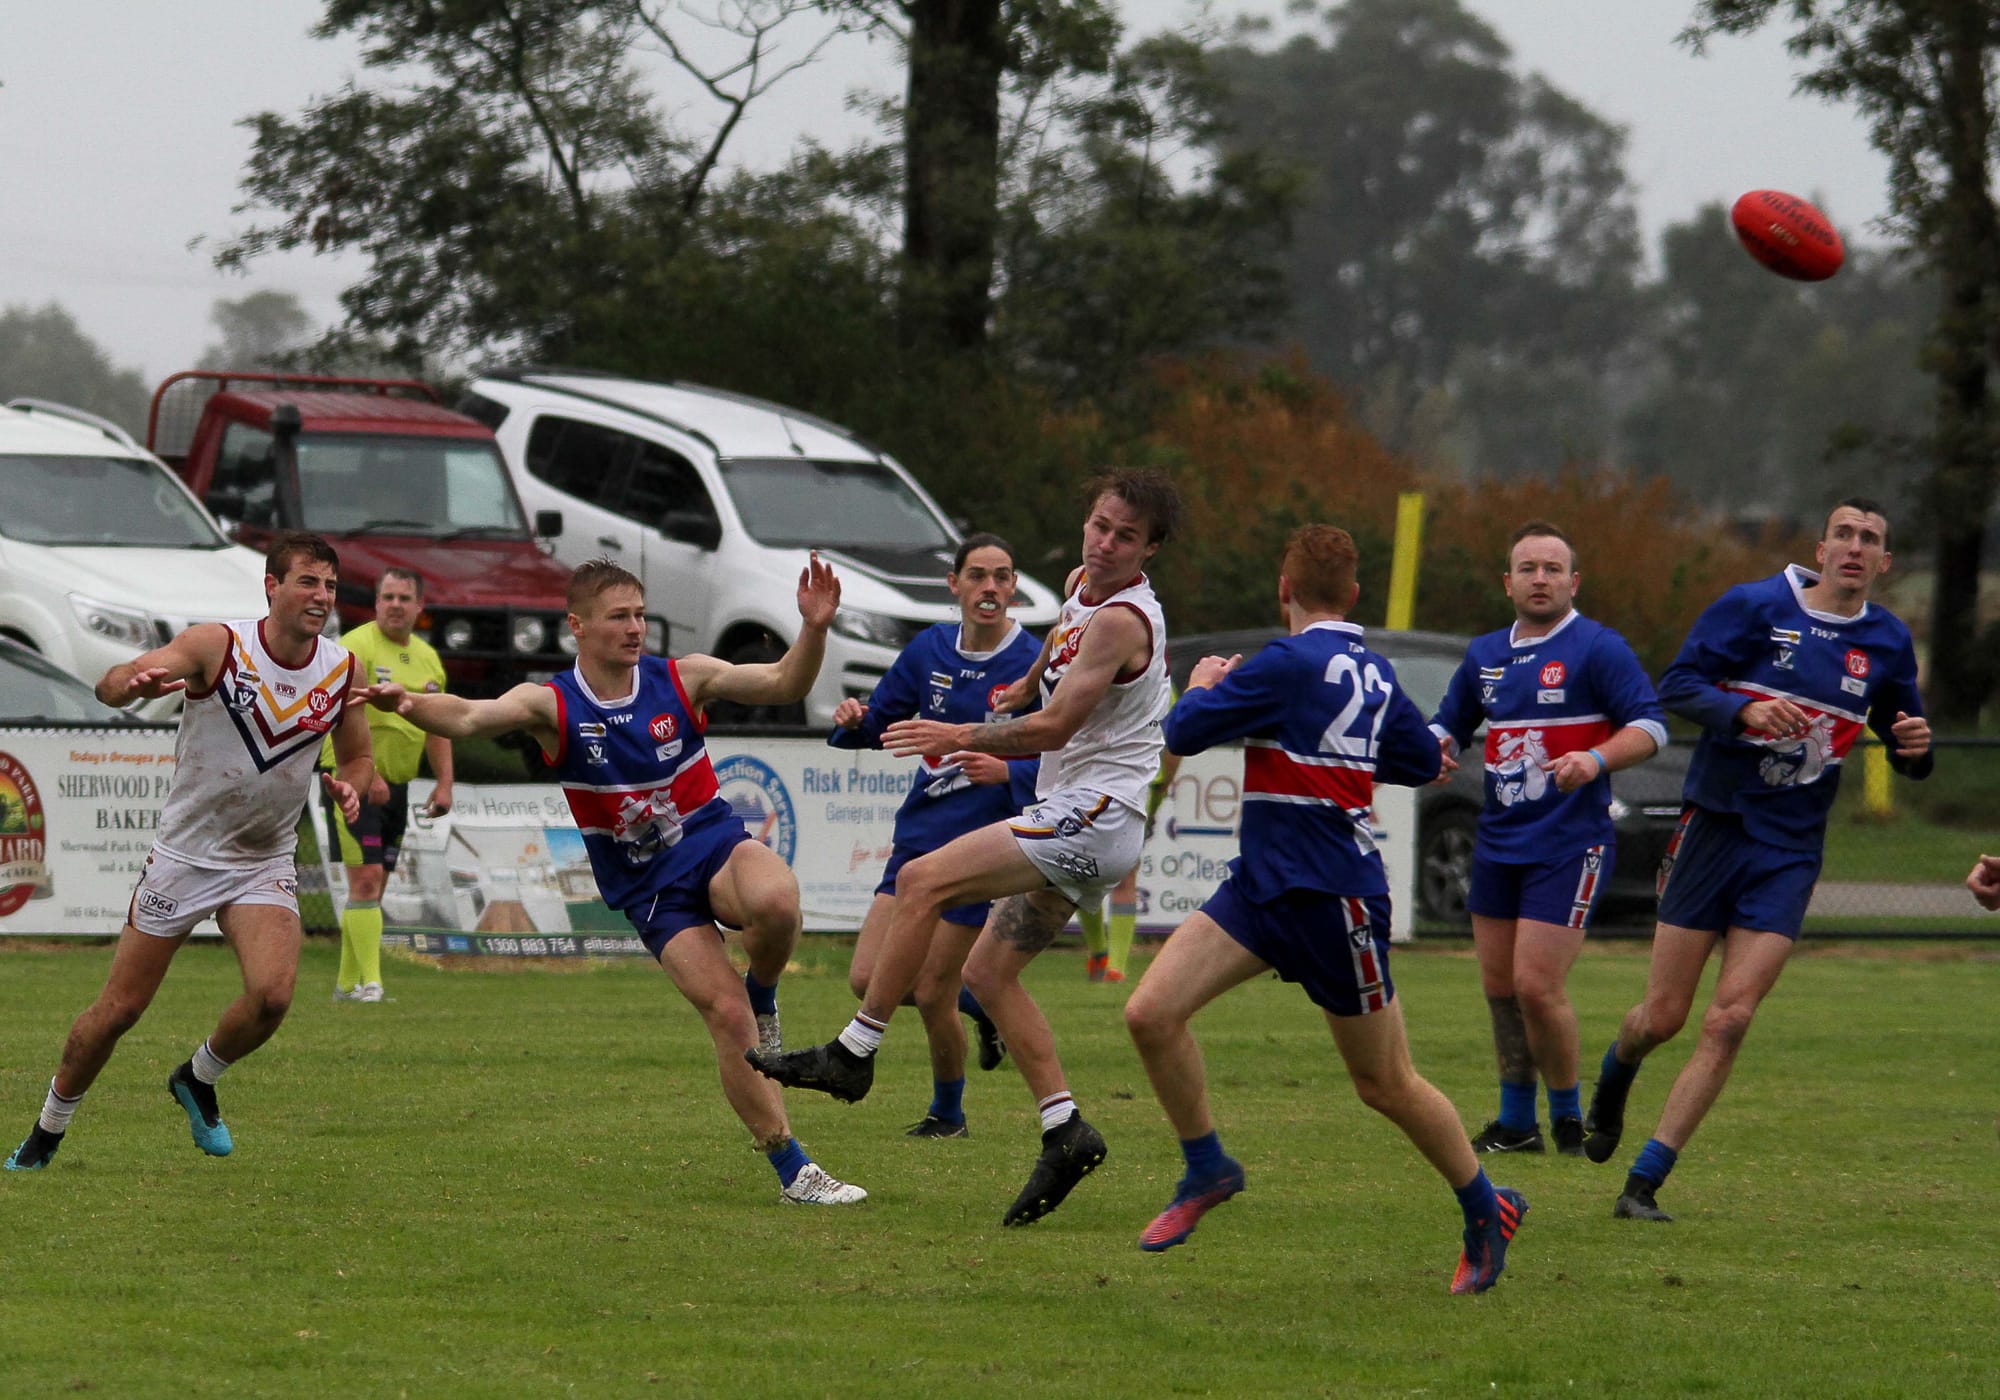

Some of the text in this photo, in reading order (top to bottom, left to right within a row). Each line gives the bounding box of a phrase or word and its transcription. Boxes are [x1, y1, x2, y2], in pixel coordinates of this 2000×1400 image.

[1809, 626, 1838, 641] TWP
[960, 669, 986, 680] TWP
[1318, 653, 1393, 759] 22
[606, 713, 634, 726] TWP
[58, 774, 150, 798] SHERWOOD
[803, 766, 841, 793] Risk
[482, 799, 539, 818] Home
[825, 801, 874, 824] General
[485, 936, 519, 953] 1300
[550, 936, 575, 953] 754
